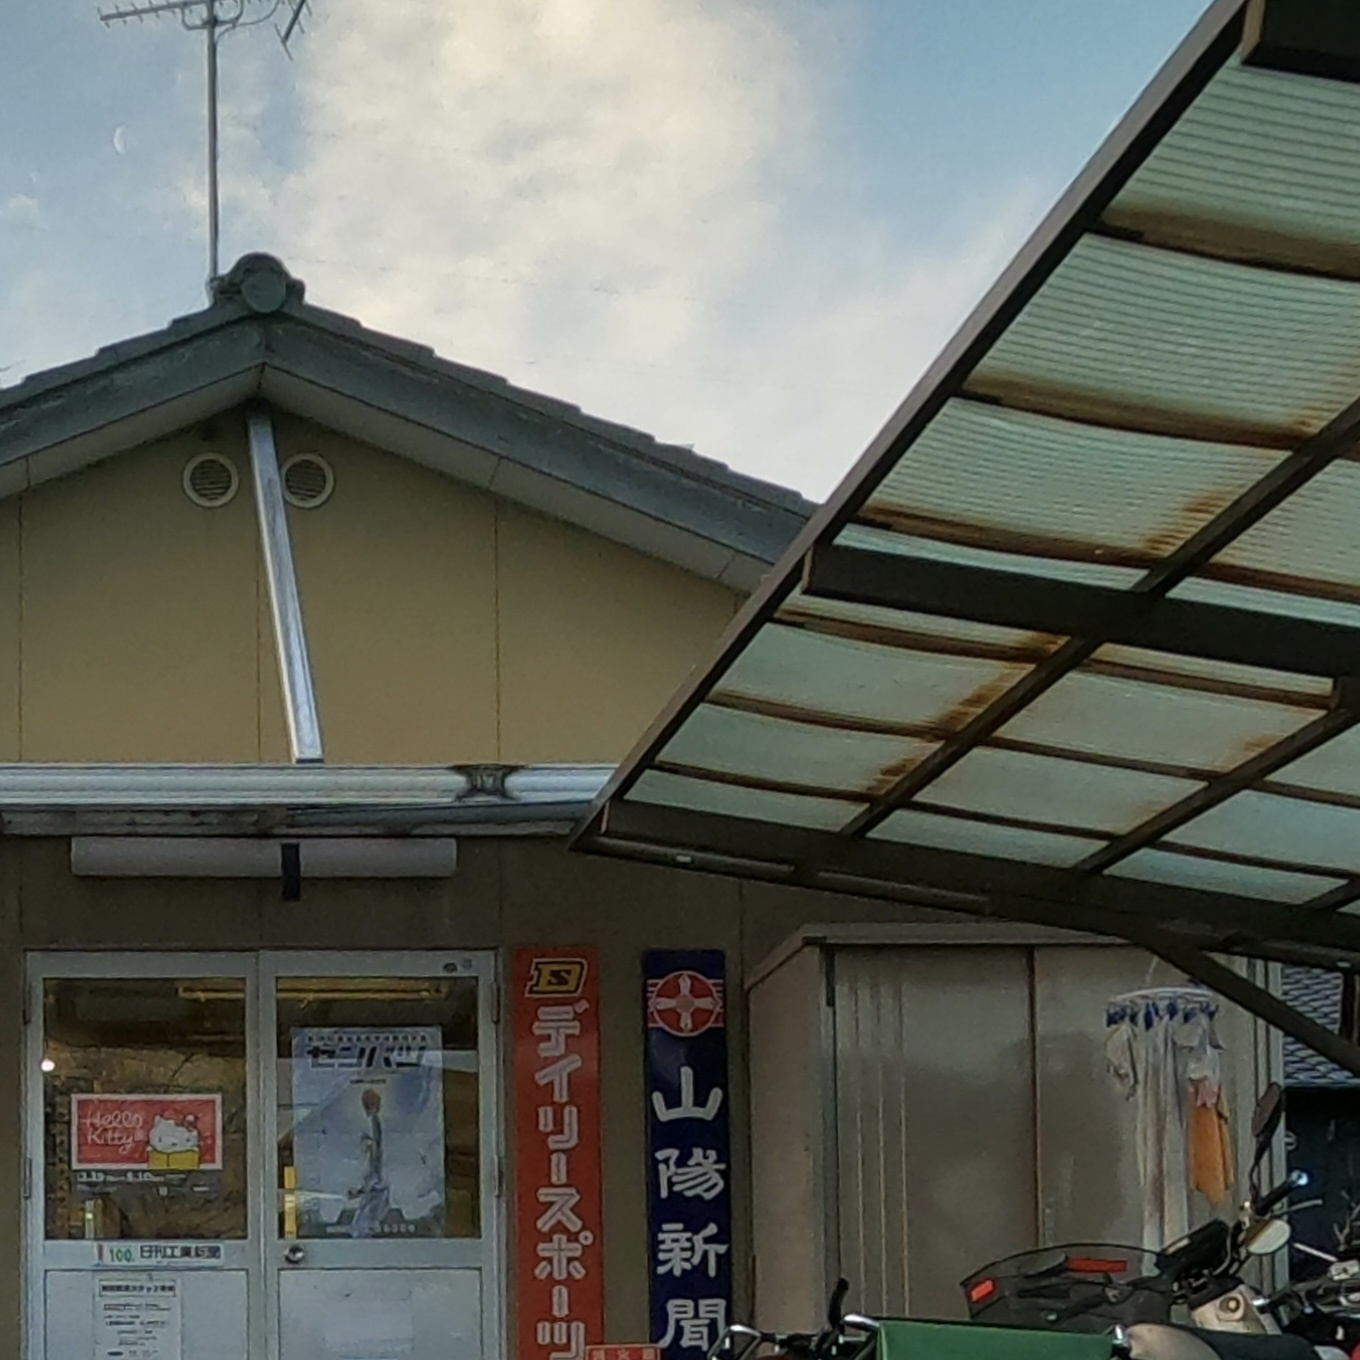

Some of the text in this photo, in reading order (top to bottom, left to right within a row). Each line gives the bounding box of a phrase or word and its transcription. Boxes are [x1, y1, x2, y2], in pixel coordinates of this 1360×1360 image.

[80, 1110, 144, 1129] Hello
[87, 1128, 135, 1154] Kitty
[651, 1065, 728, 1352] 山陽新聞
